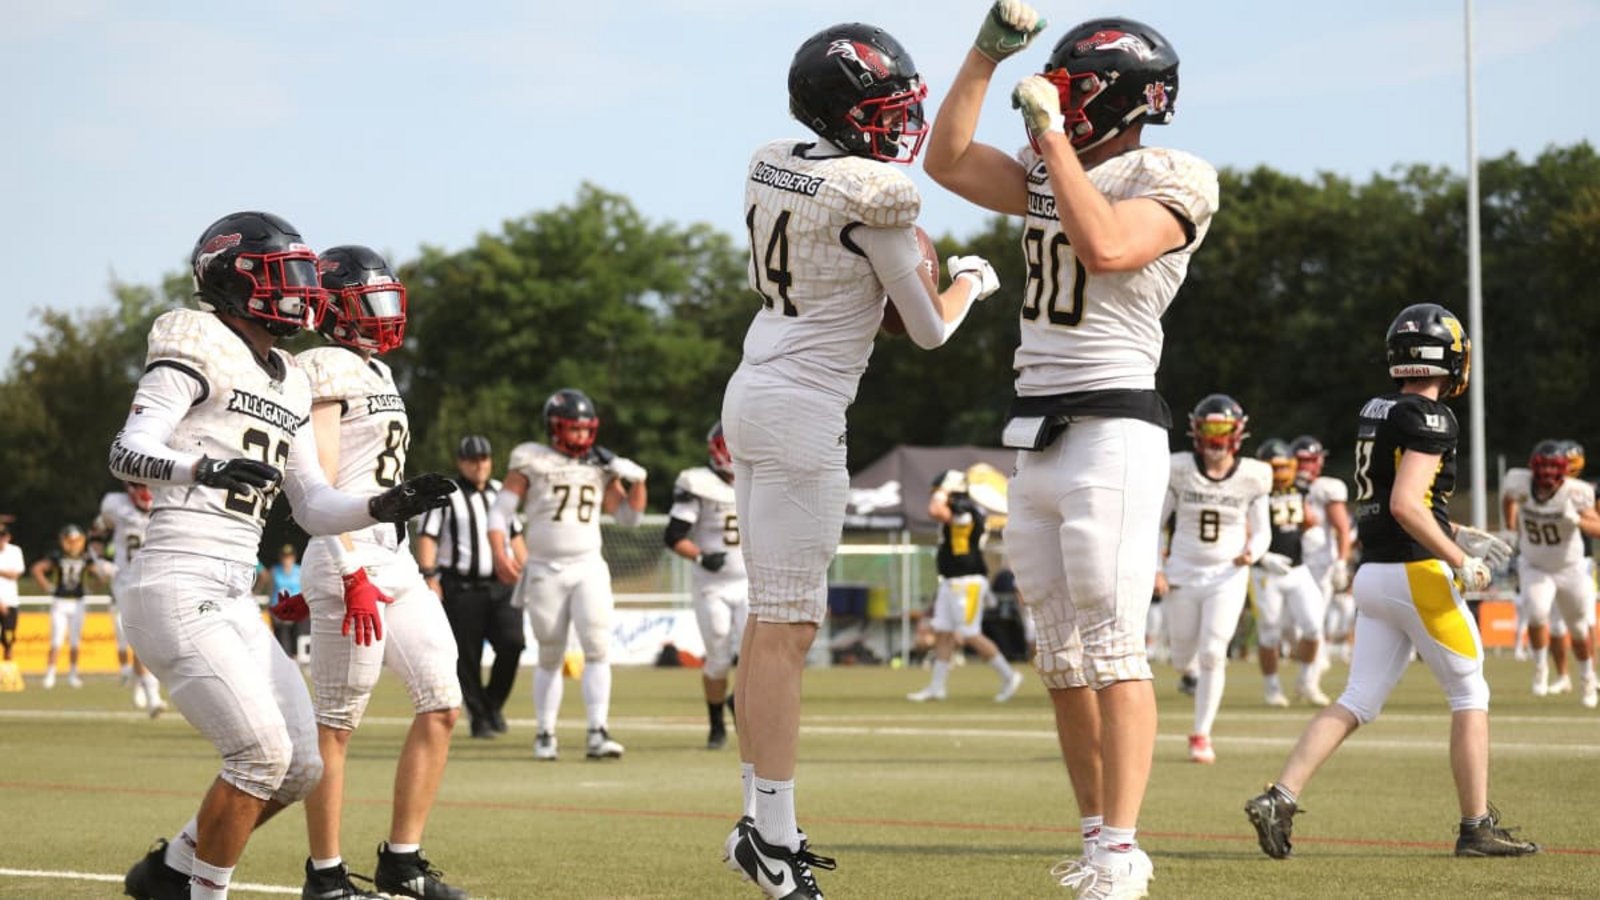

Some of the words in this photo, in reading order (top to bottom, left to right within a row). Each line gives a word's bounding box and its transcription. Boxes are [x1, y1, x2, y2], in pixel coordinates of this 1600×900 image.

[746, 203, 798, 317] 14
[1023, 228, 1086, 326] 80
[1393, 366, 1431, 376] Riddell
[228, 389, 300, 436] ALLIGATORS
[552, 485, 595, 523] 76
[1200, 510, 1220, 543] 8
